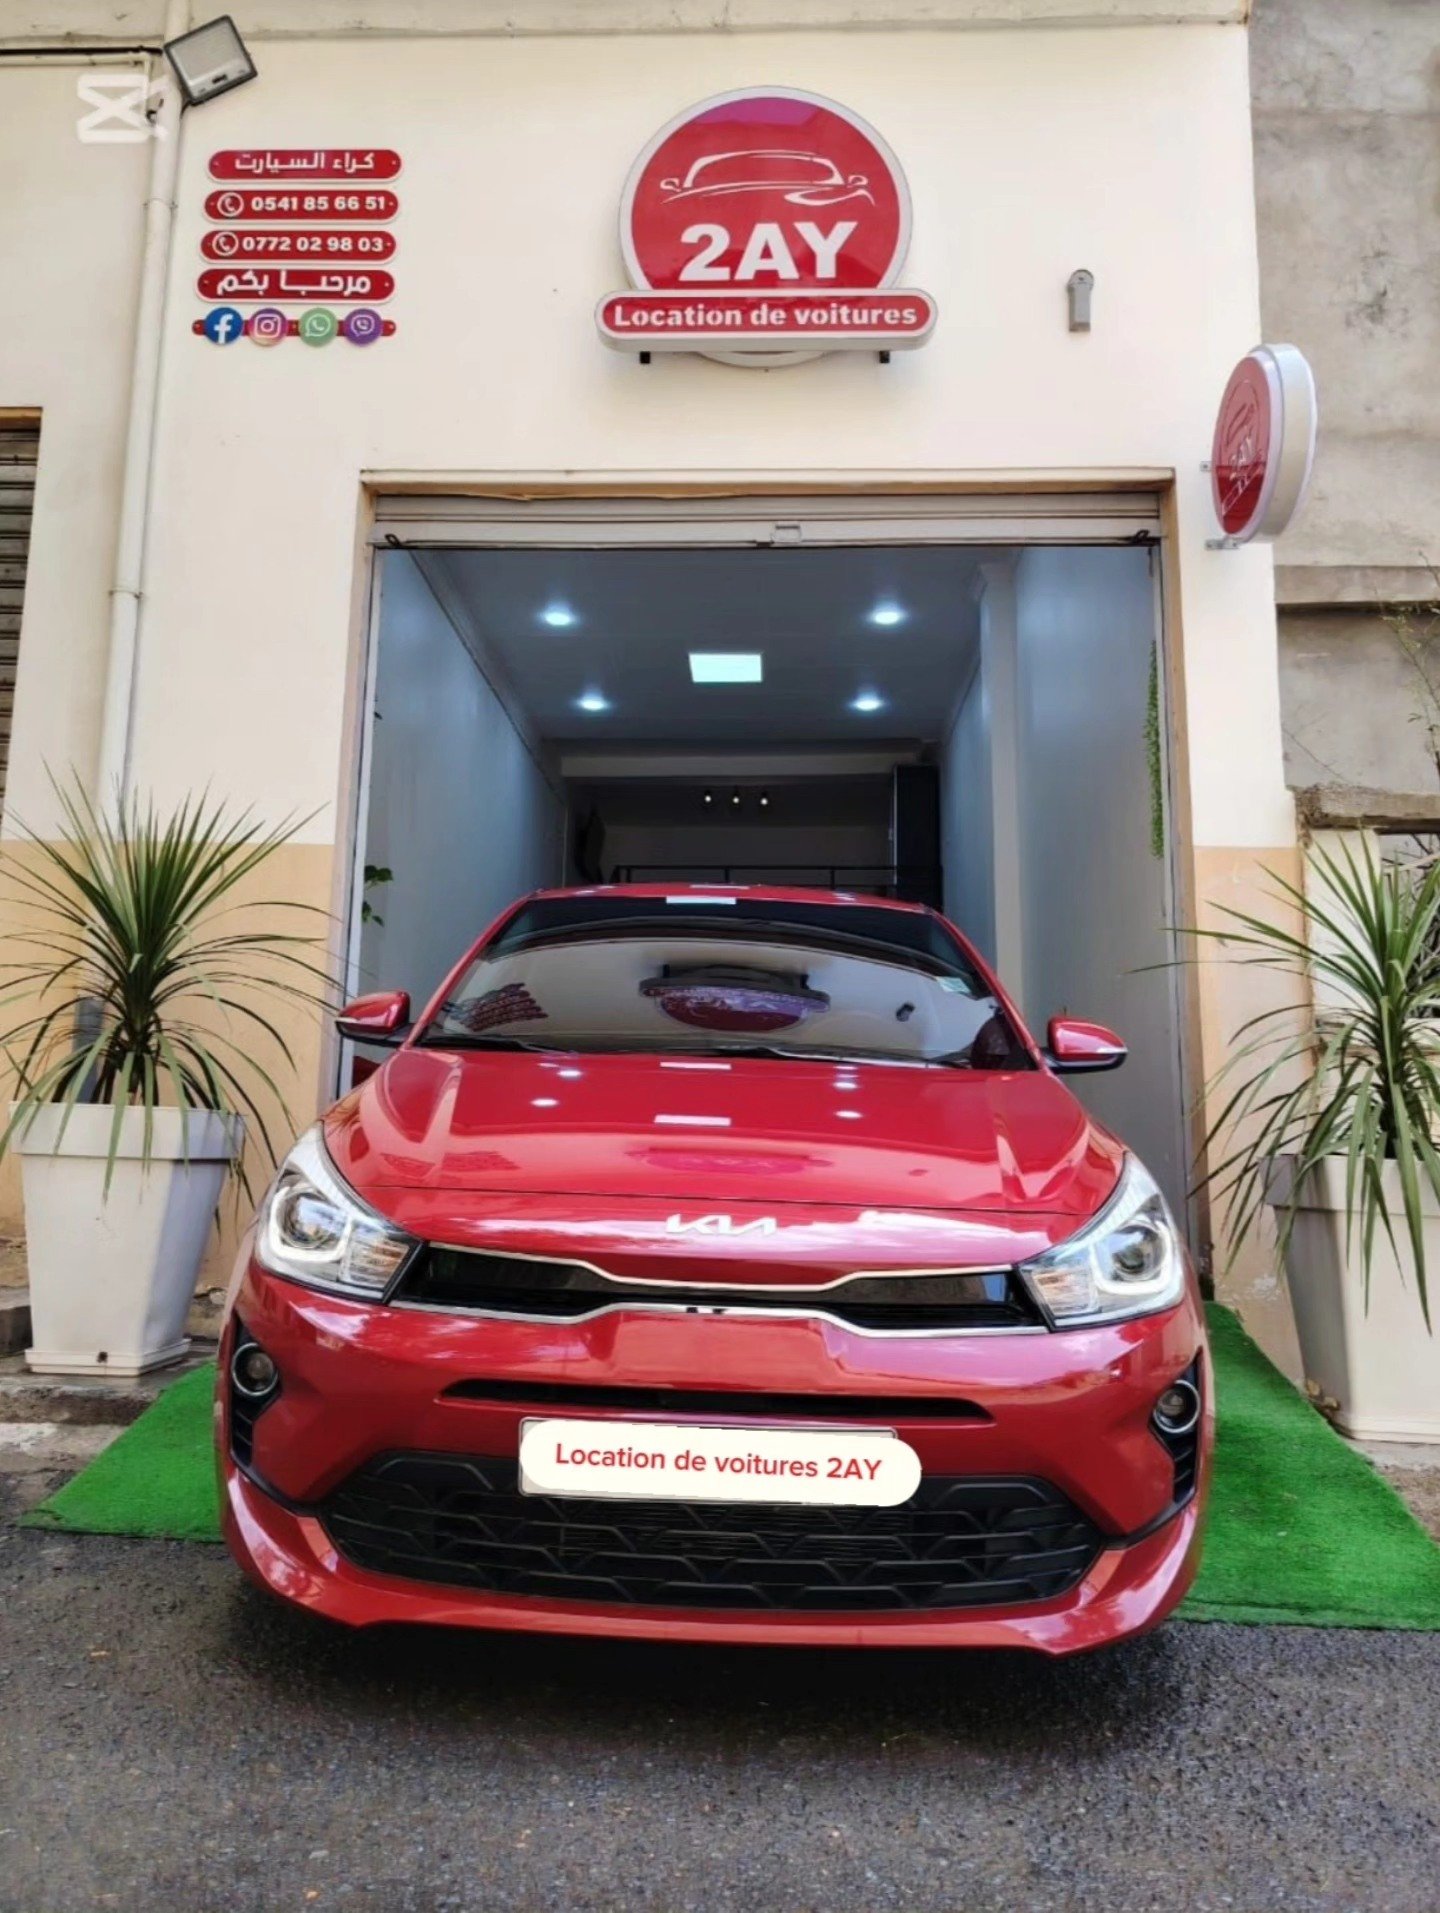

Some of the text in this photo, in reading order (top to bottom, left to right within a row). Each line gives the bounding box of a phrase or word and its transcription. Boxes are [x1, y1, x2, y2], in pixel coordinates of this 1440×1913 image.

[331, 151, 375, 173] كراء
[251, 196, 386, 211] 0541 85 66 51
[242, 236, 384, 252] 0772 02 98 03
[678, 221, 858, 282] 2AY
[216, 269, 371, 297] مرحبا بكم
[614, 302, 918, 327] Location de voitures
